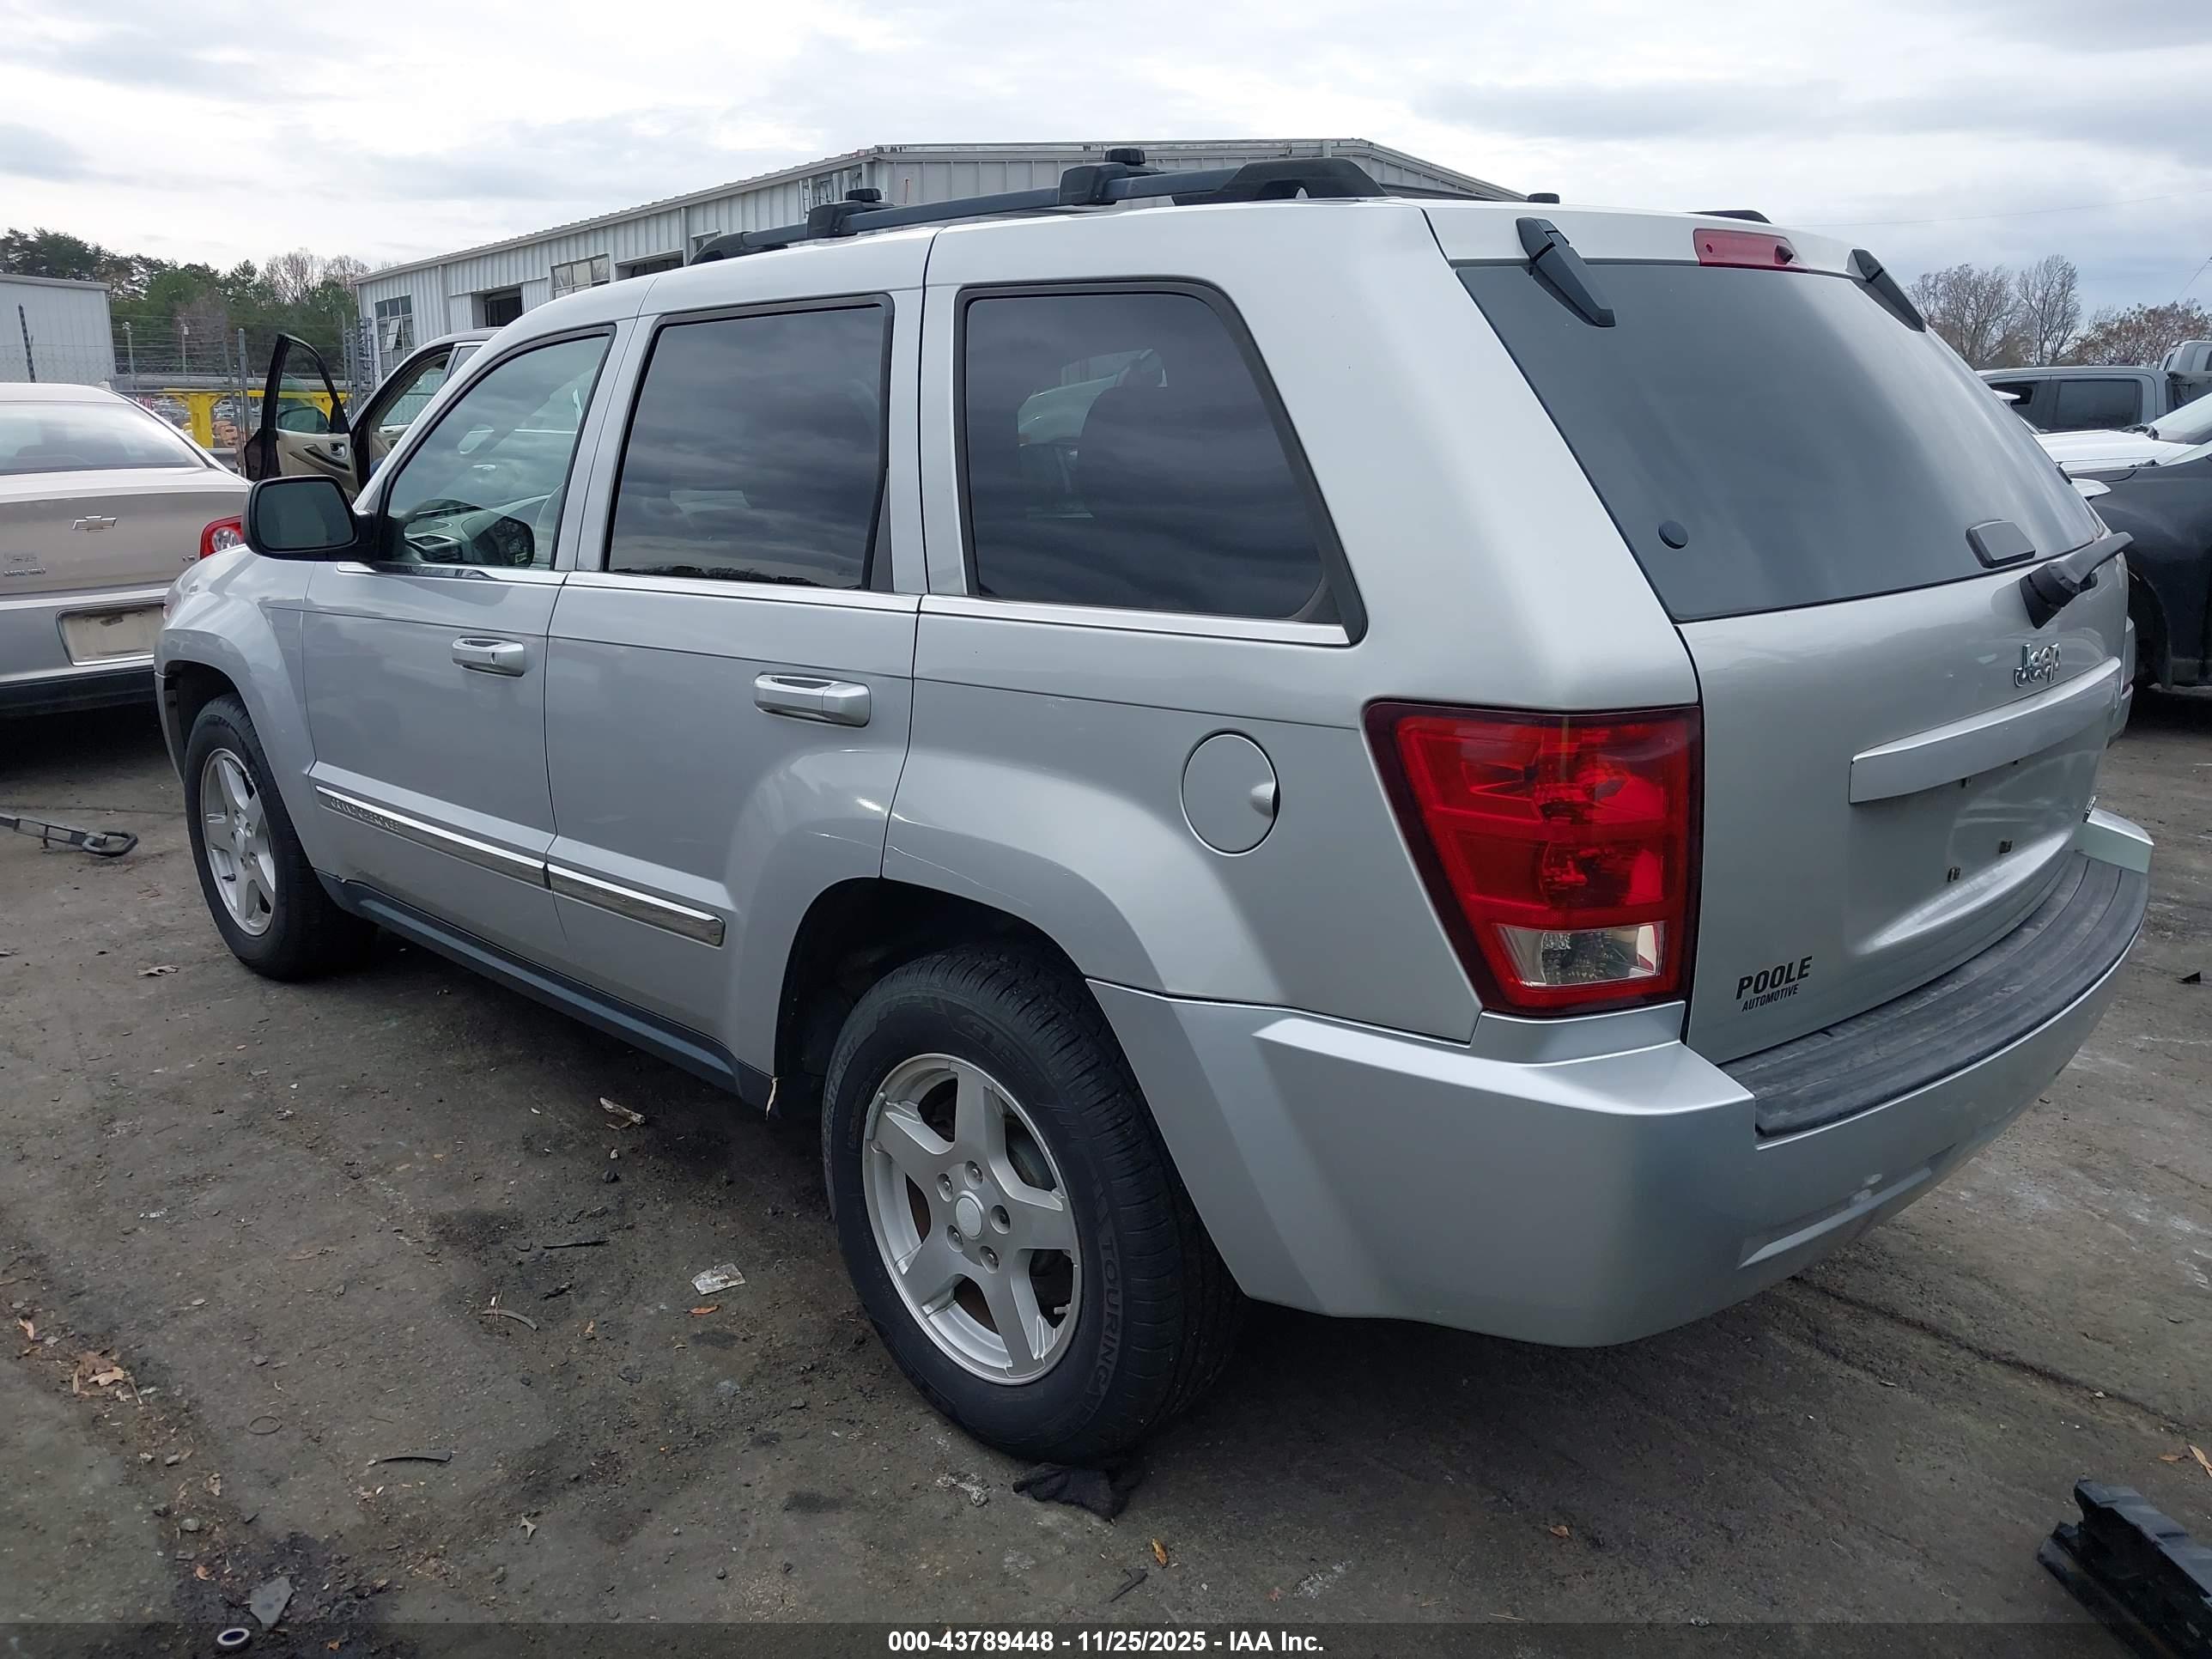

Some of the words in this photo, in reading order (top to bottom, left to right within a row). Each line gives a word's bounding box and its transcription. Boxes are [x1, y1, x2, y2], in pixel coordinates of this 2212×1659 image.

[2014, 643, 2062, 688] Jeep
[1735, 955, 1814, 1000] POOLE
[1741, 983, 1799, 1012] AUTOMOTIVE
[1097, 1242, 1120, 1390] TOURING
